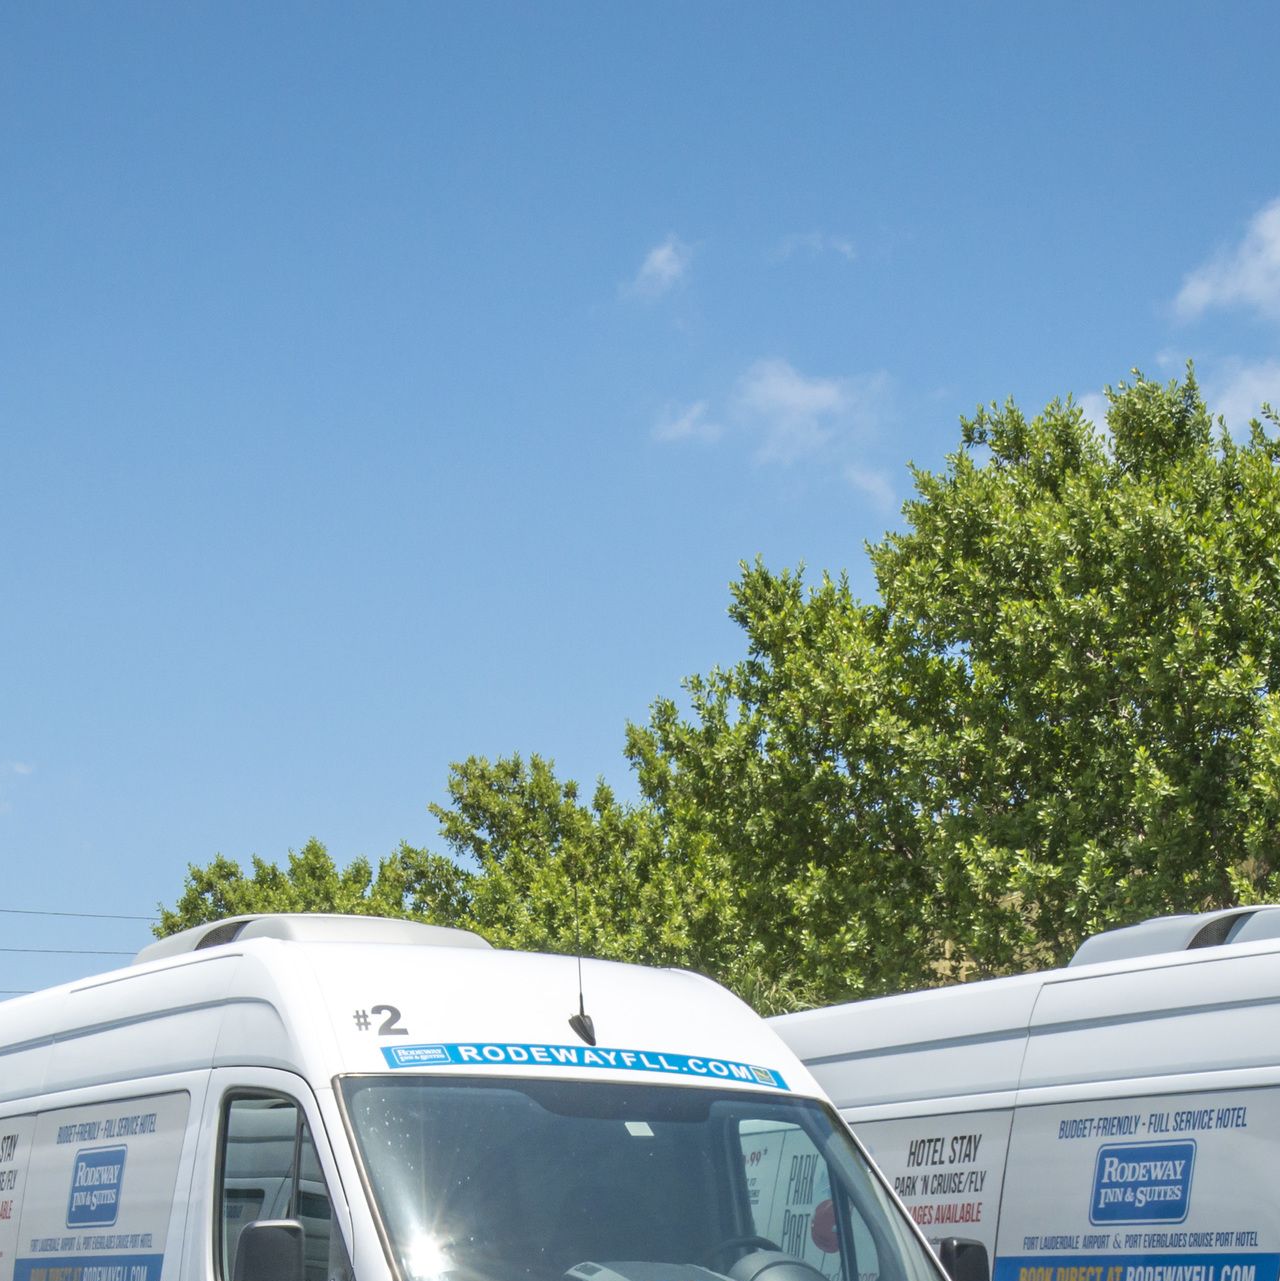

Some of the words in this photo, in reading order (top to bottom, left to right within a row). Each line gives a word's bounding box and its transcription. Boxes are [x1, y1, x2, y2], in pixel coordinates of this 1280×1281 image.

[352, 1004, 409, 1036] #2
[458, 1045, 753, 1080] RODEWAYFLL.COM
[1058, 1115, 1141, 1140] BUDGET-FRIENDLY
[1147, 1113, 1170, 1134] FULL
[1173, 1109, 1215, 1132] SERVICE
[1215, 1107, 1247, 1128] HOTEL
[0, 1134, 19, 1163] STAY
[907, 1137, 945, 1168] HOTEL
[949, 1134, 982, 1164] STAY
[75, 1162, 120, 1187] RODEWAY
[786, 1154, 819, 1206] PARK
[930, 1170, 987, 1195] CRUISE/FLY
[1101, 1157, 1186, 1183] RODEWAY
[91, 1189, 117, 1210] SUITES
[1098, 1188, 1122, 1208] INN
[1124, 1188, 1134, 1202] &
[1135, 1185, 1183, 1207] SUITES
[934, 1202, 983, 1225] AVAILABLE
[781, 1209, 811, 1259] PORT
[1023, 1236, 1039, 1250] FORT
[1039, 1235, 1080, 1250] LAUDERDALE
[1082, 1234, 1110, 1249] AIRPORT
[1112, 1233, 1121, 1249] &
[1124, 1234, 1143, 1249] PORT
[1142, 1232, 1187, 1248] EVERGLADES
[1188, 1232, 1214, 1248] CRUISE
[1215, 1232, 1235, 1247] PORT
[1235, 1231, 1259, 1247] HOTEL
